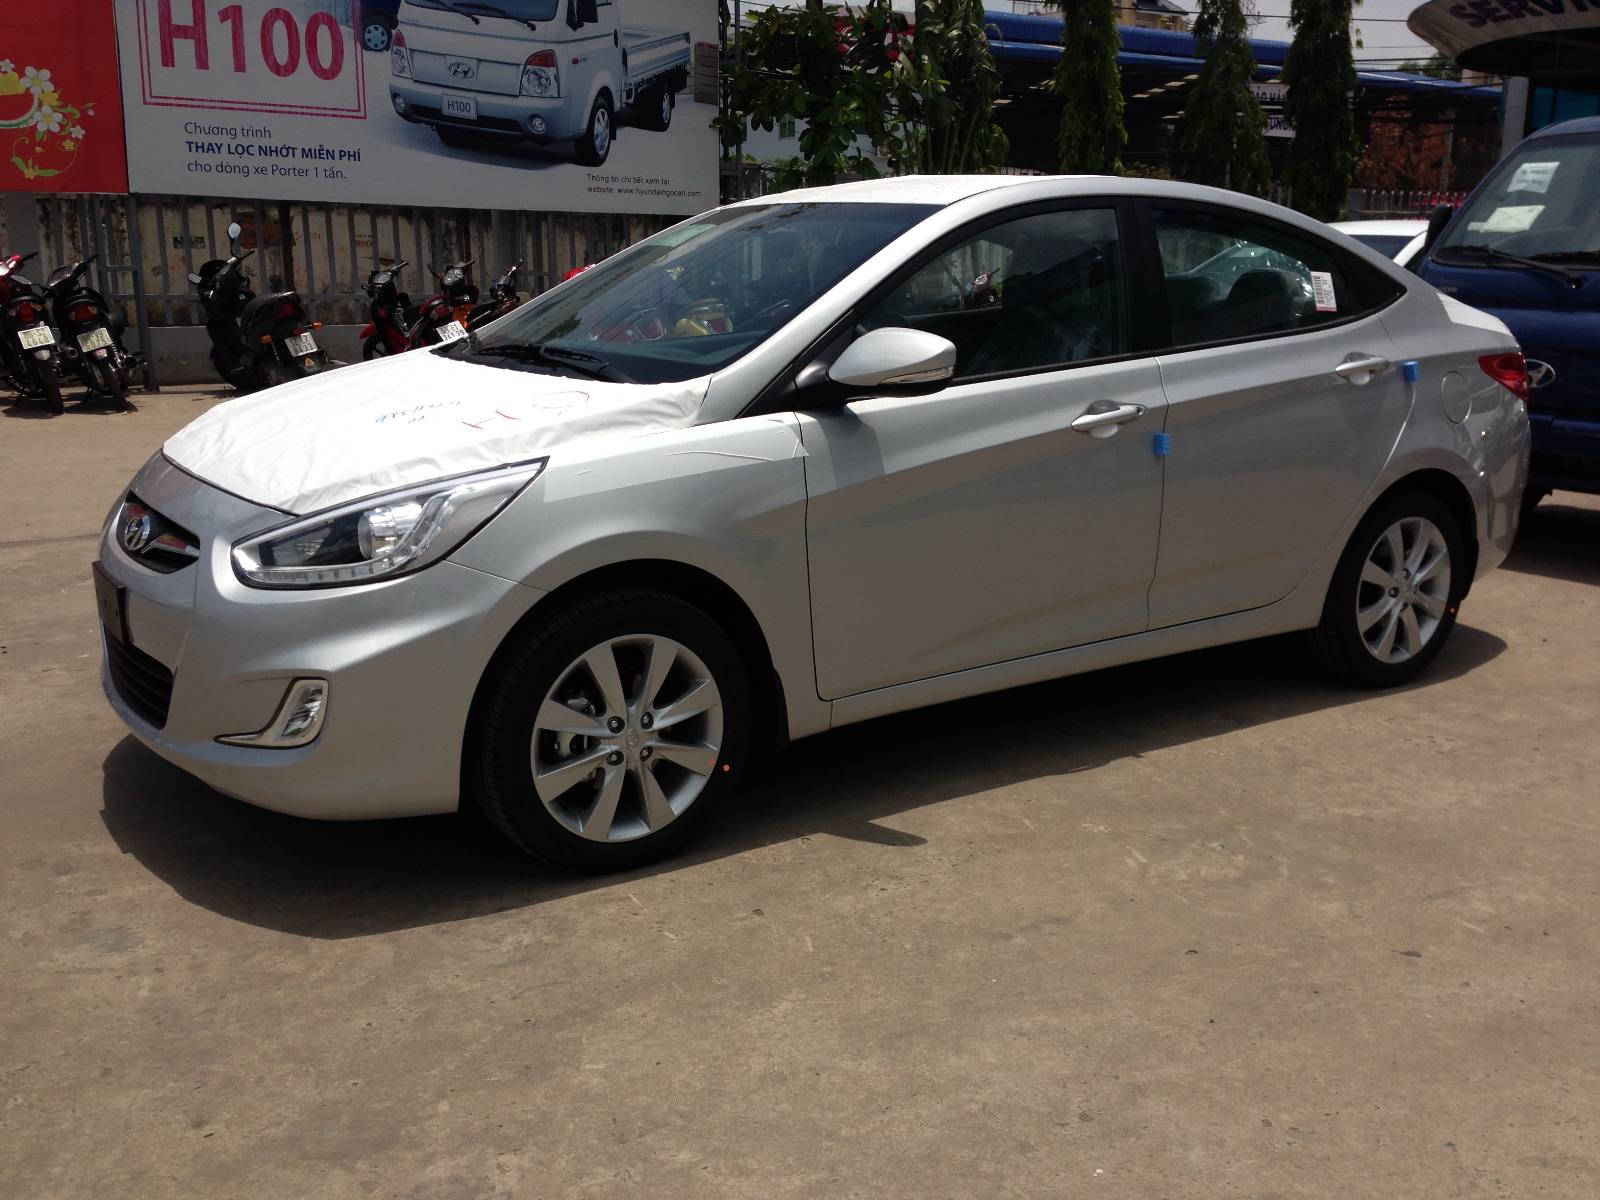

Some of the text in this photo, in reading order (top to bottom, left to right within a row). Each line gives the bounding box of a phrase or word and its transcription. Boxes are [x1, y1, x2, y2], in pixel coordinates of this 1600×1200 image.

[158, 0, 344, 80] H100
[447, 99, 471, 113] H100
[184, 121, 272, 139] Chương trình
[185, 141, 361, 162] THAY LỌC NHỚT MIỄN PHÍ
[187, 160, 212, 173] cho
[215, 161, 250, 177] dòng
[253, 164, 268, 175] xe
[271, 164, 309, 177] Porter
[323, 167, 347, 179] tấn.
[586, 173, 609, 184] Thông
